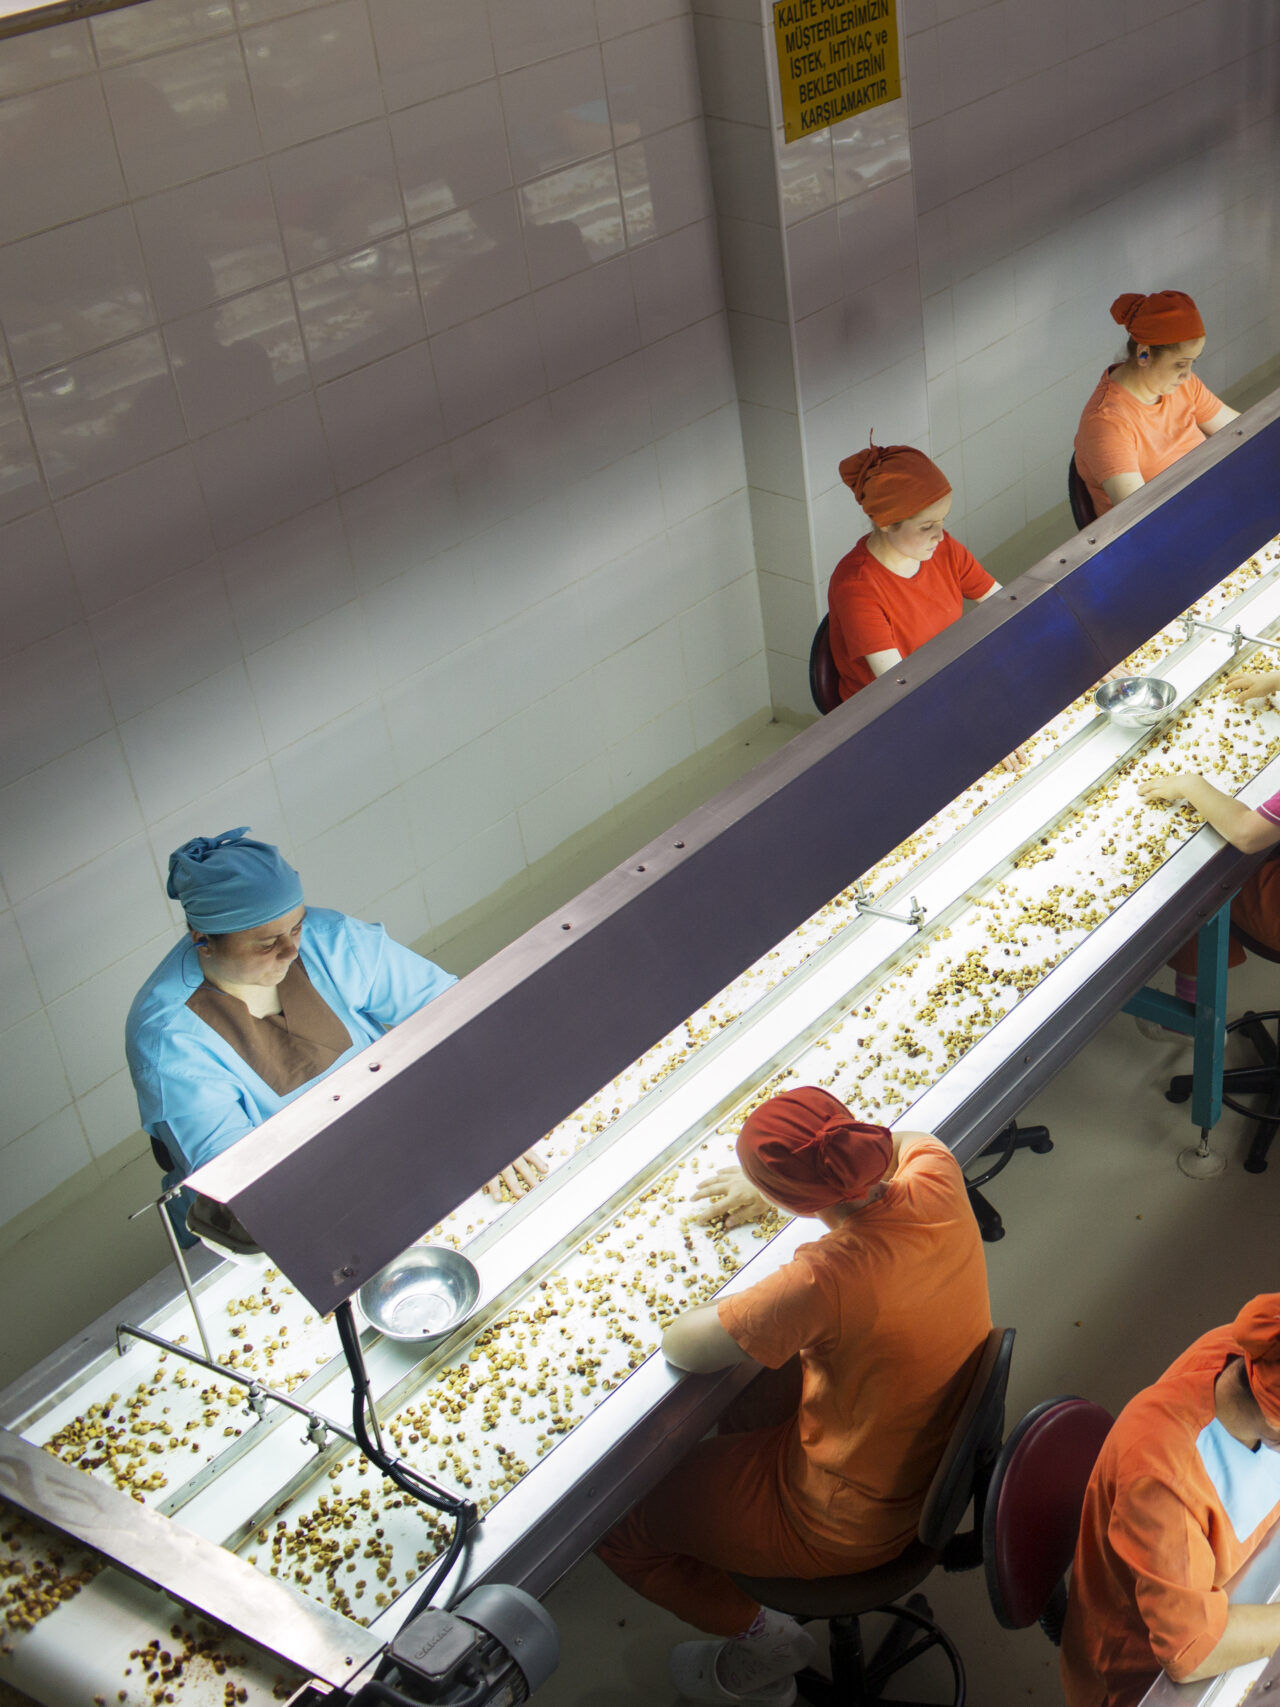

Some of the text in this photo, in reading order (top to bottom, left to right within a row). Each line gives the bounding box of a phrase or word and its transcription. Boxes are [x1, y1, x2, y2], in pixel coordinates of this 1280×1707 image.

[778, 0, 817, 28] KALİTE
[785, 0, 888, 53] MÜŞTERİLERİMİZİN
[790, 29, 888, 80] İSTEK, İHTİYAÇ ve
[798, 48, 885, 104] BEKLENTİLERİNİ
[801, 79, 887, 130] KARŞILAMAKTIR
